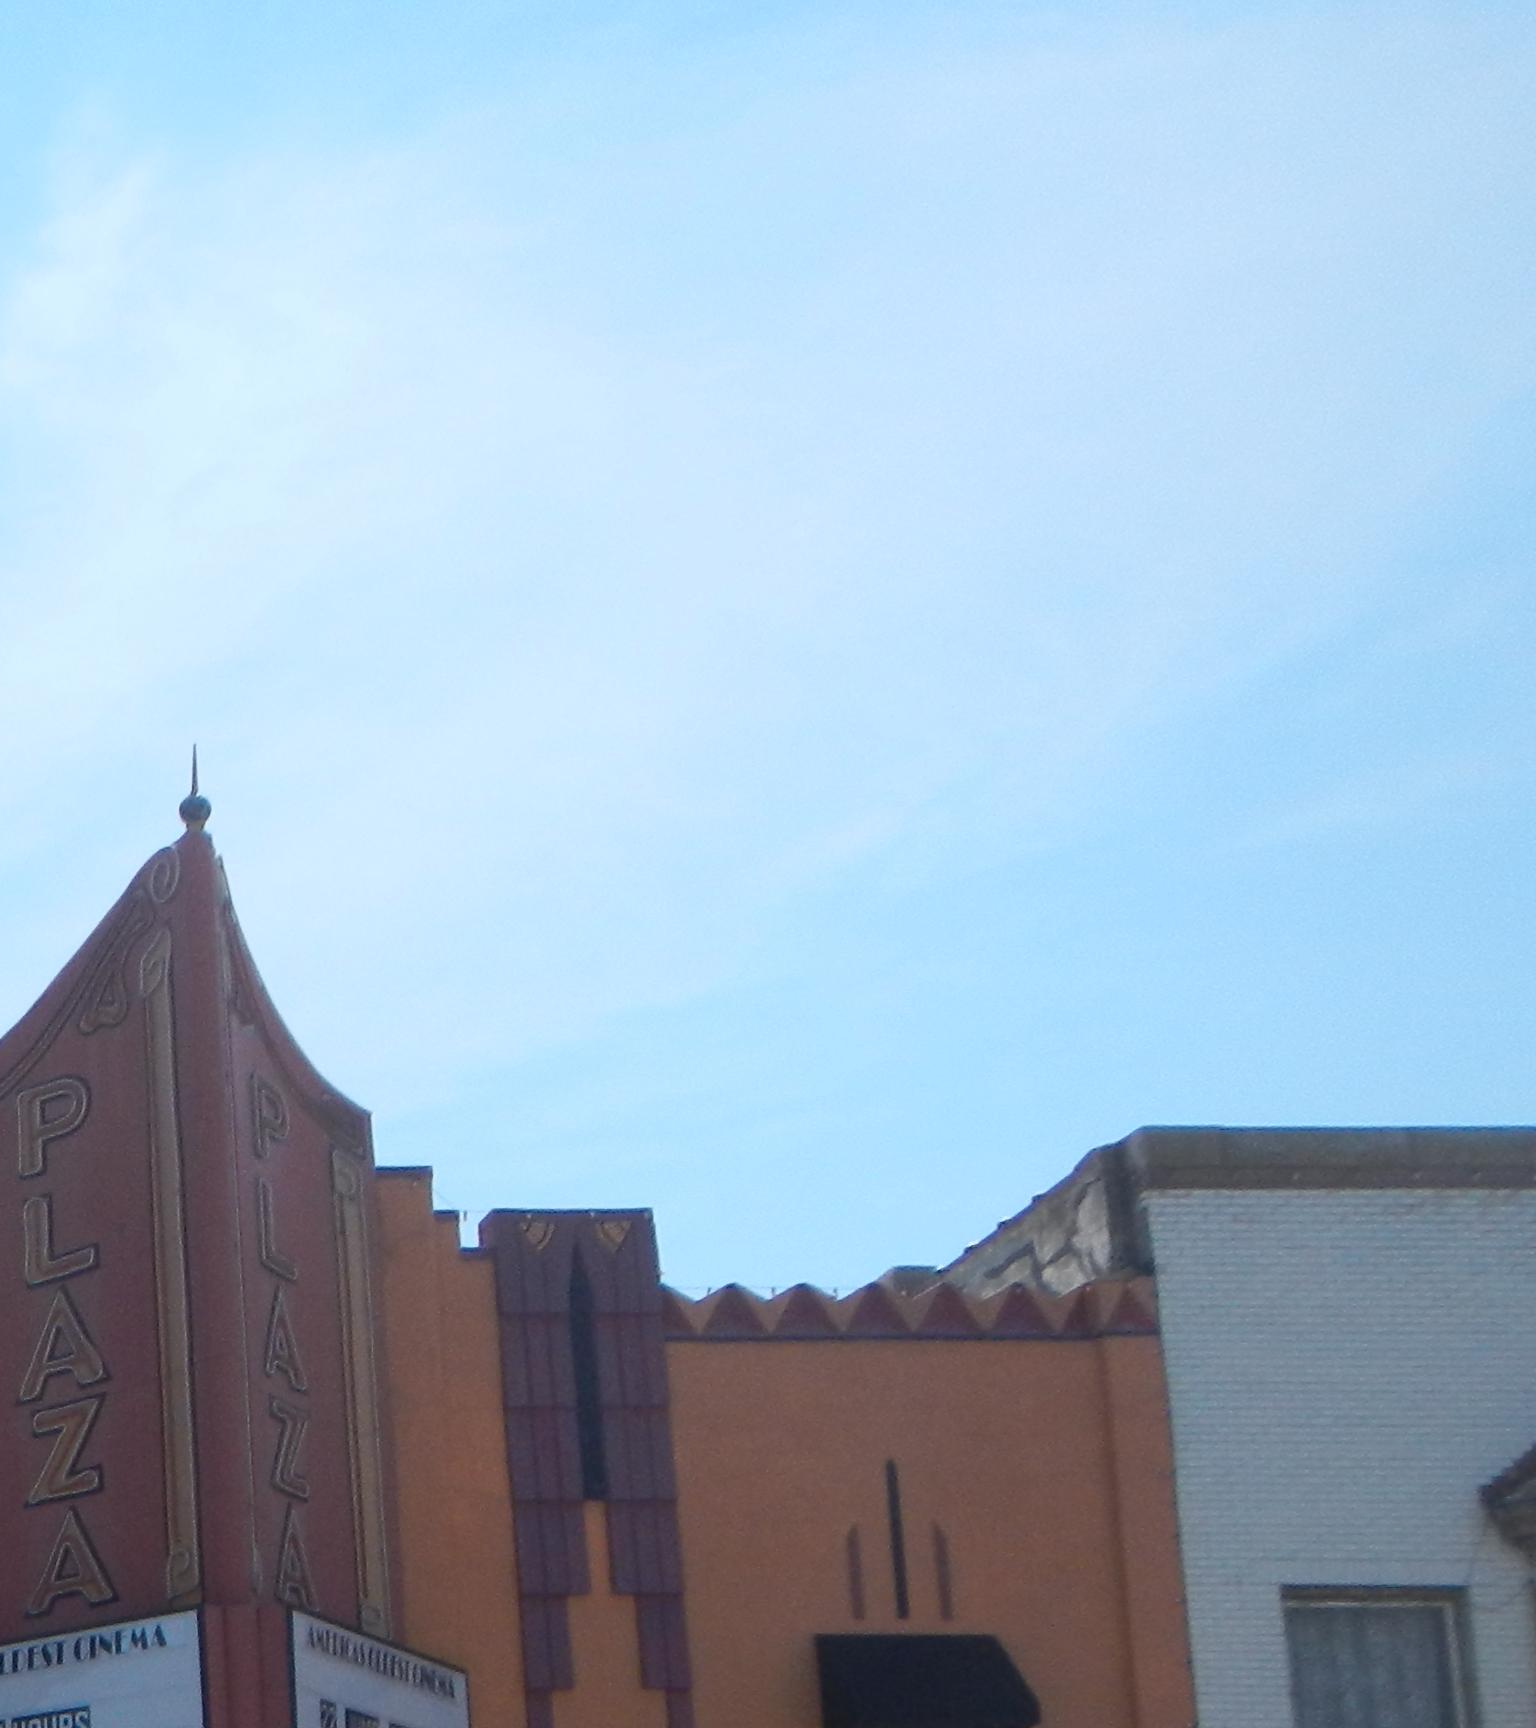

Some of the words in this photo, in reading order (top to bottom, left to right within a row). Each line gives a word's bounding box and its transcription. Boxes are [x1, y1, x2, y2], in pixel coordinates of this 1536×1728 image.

[17, 1071, 116, 1618] PLAZA
[250, 1068, 321, 1613] PLAZA
[73, 1623, 168, 1663] CINEMA
